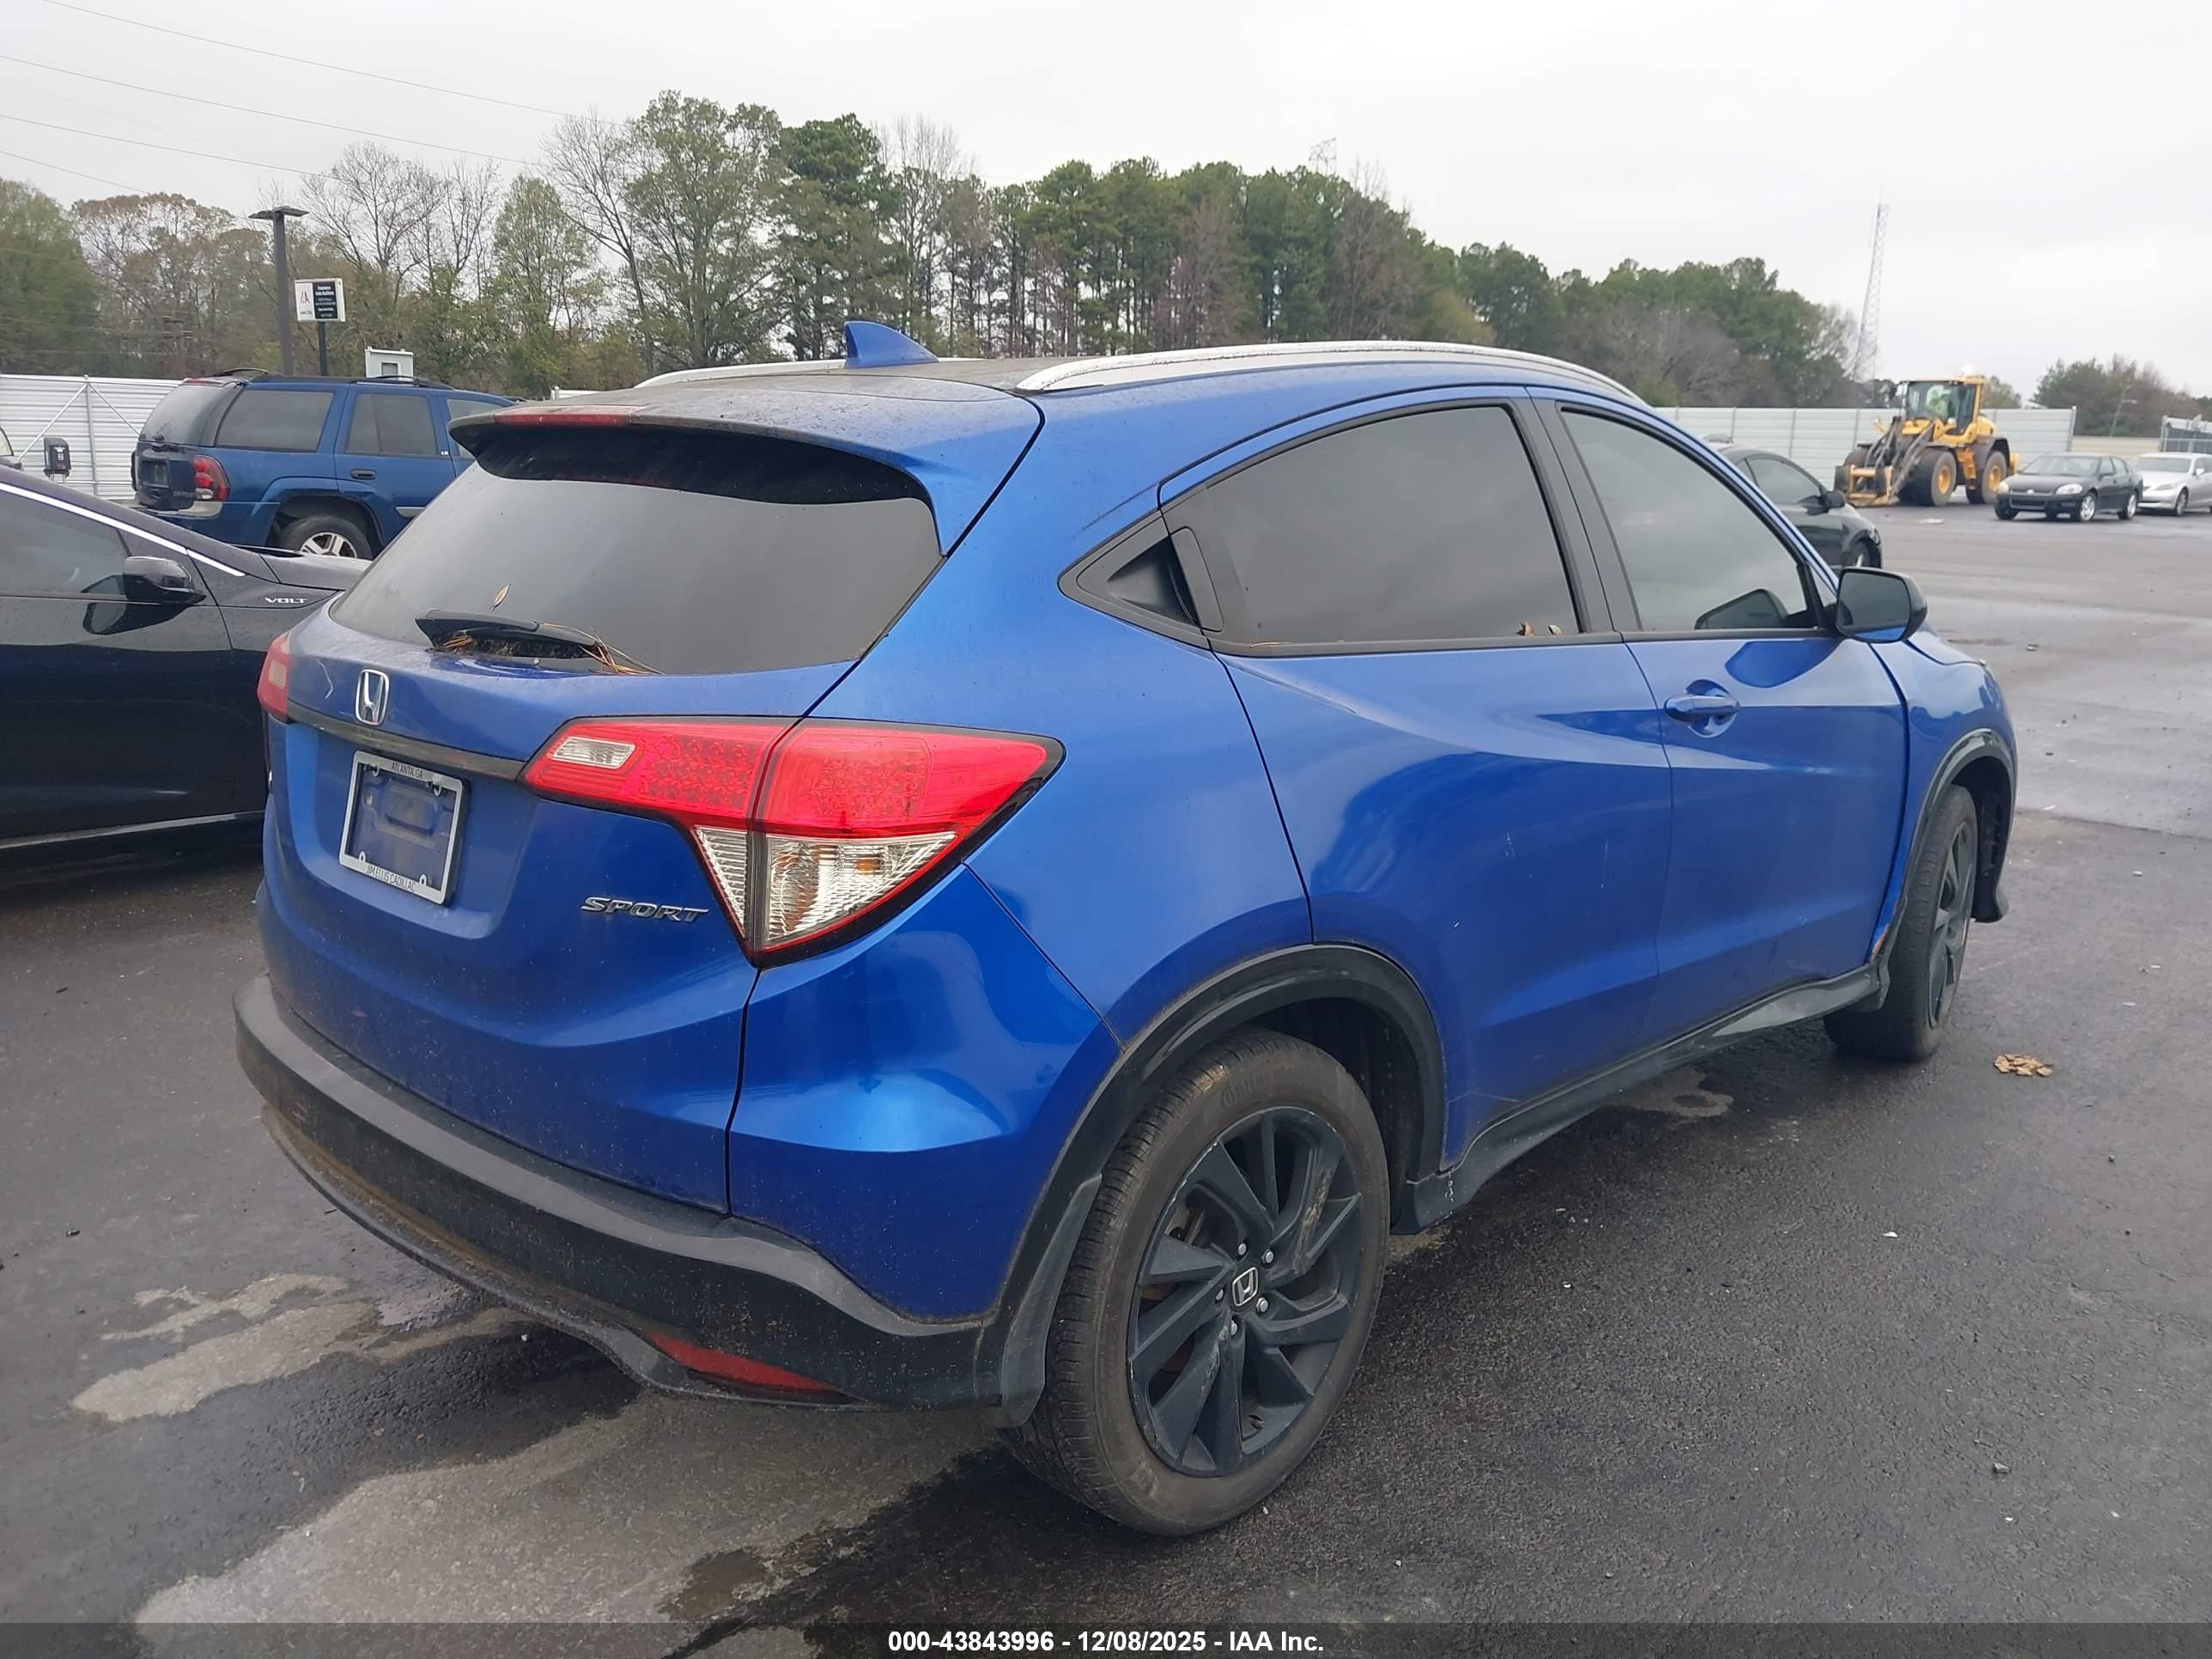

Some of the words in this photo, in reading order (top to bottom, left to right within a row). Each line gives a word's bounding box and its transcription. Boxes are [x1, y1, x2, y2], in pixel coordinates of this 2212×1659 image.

[415, 769, 423, 780] GA
[366, 865, 375, 877] JIM
[375, 867, 390, 882] ELLIS
[389, 874, 416, 892] CADILLAC
[580, 896, 710, 922] SPORT
